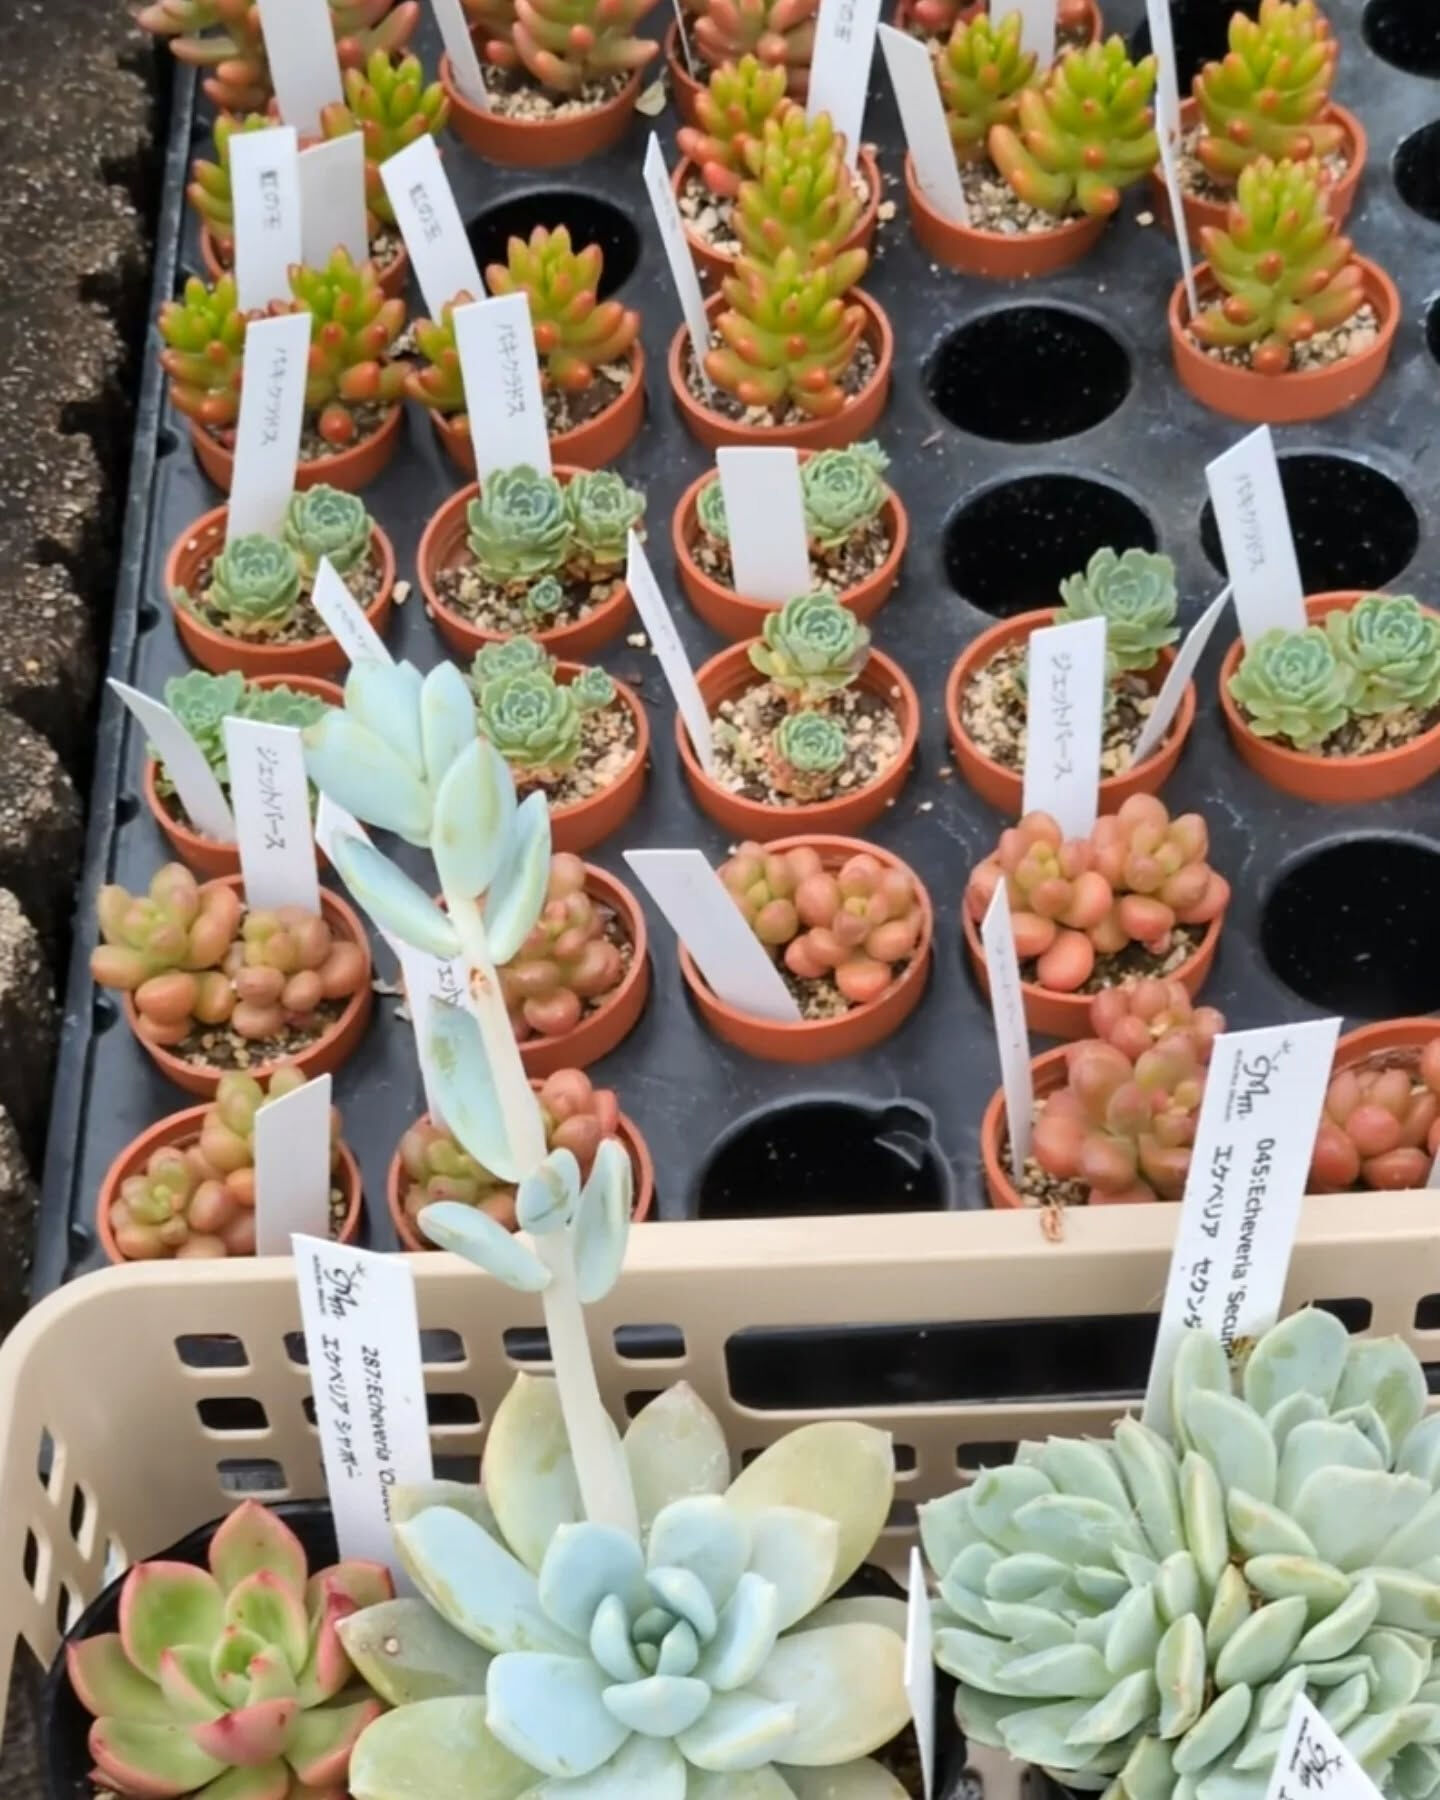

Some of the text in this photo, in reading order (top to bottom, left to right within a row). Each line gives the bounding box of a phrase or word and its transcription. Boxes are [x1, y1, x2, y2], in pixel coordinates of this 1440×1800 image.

[1200, 1144, 1233, 1239] エケベリア
[1231, 1137, 1276, 1280] 045:Echeveria
[361, 1345, 393, 1461] 287:Echeveria
